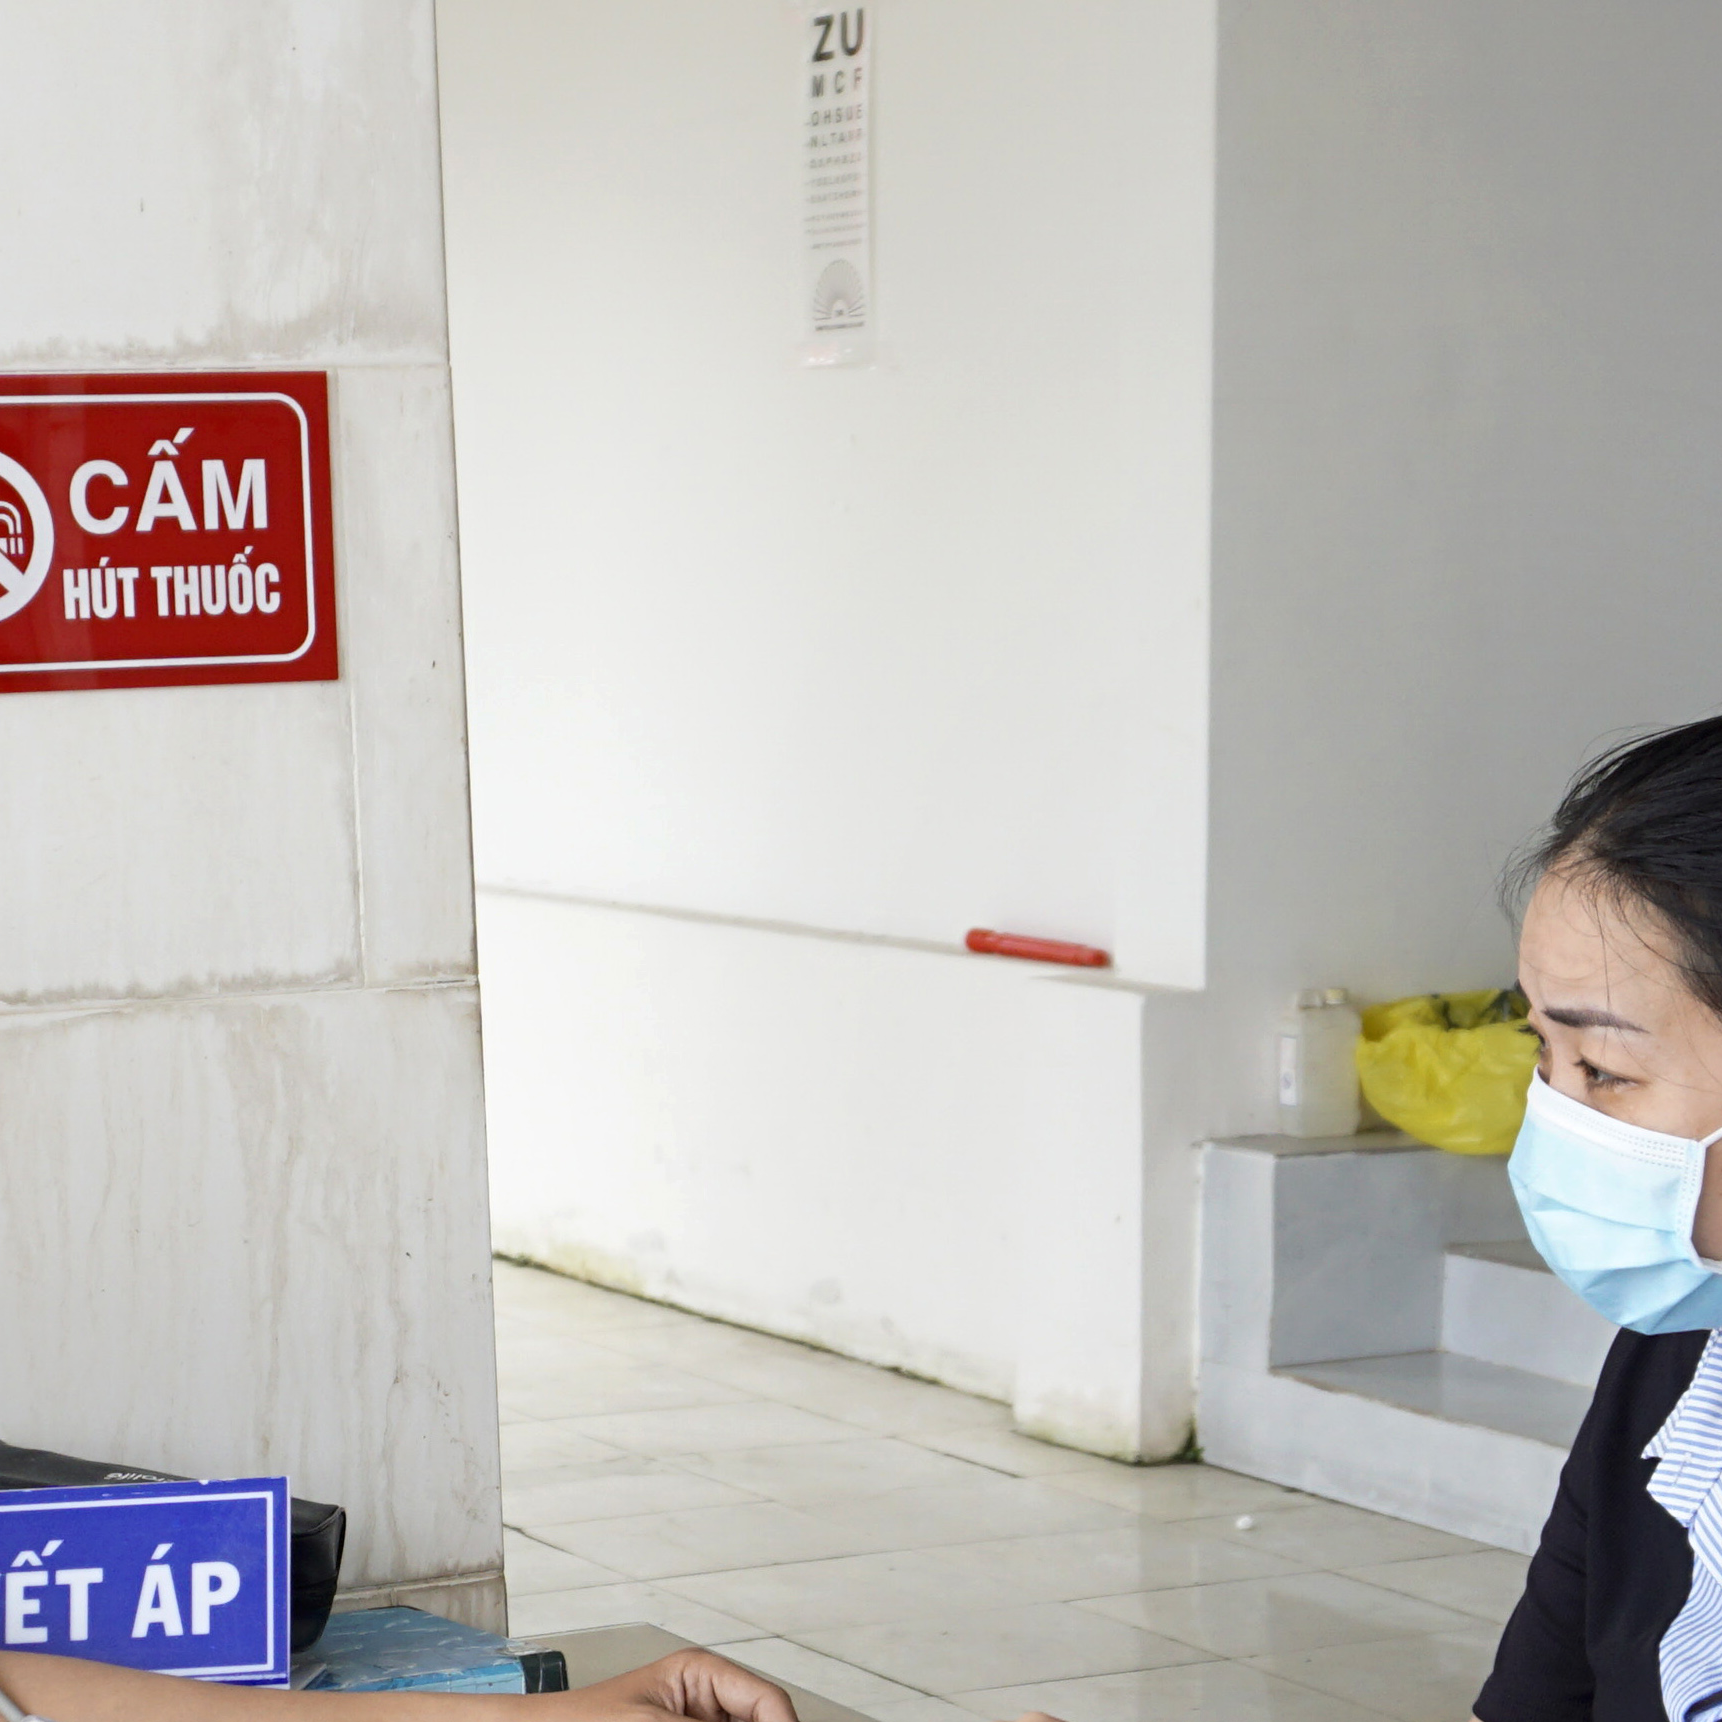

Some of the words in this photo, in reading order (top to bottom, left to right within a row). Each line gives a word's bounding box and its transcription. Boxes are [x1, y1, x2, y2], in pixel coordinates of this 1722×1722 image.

[812, 7, 864, 62] ZU
[68, 427, 269, 535] CẤM
[63, 556, 140, 620] HÚT
[150, 545, 281, 618] THUỐC
[131, 1543, 241, 1639] ÁP
